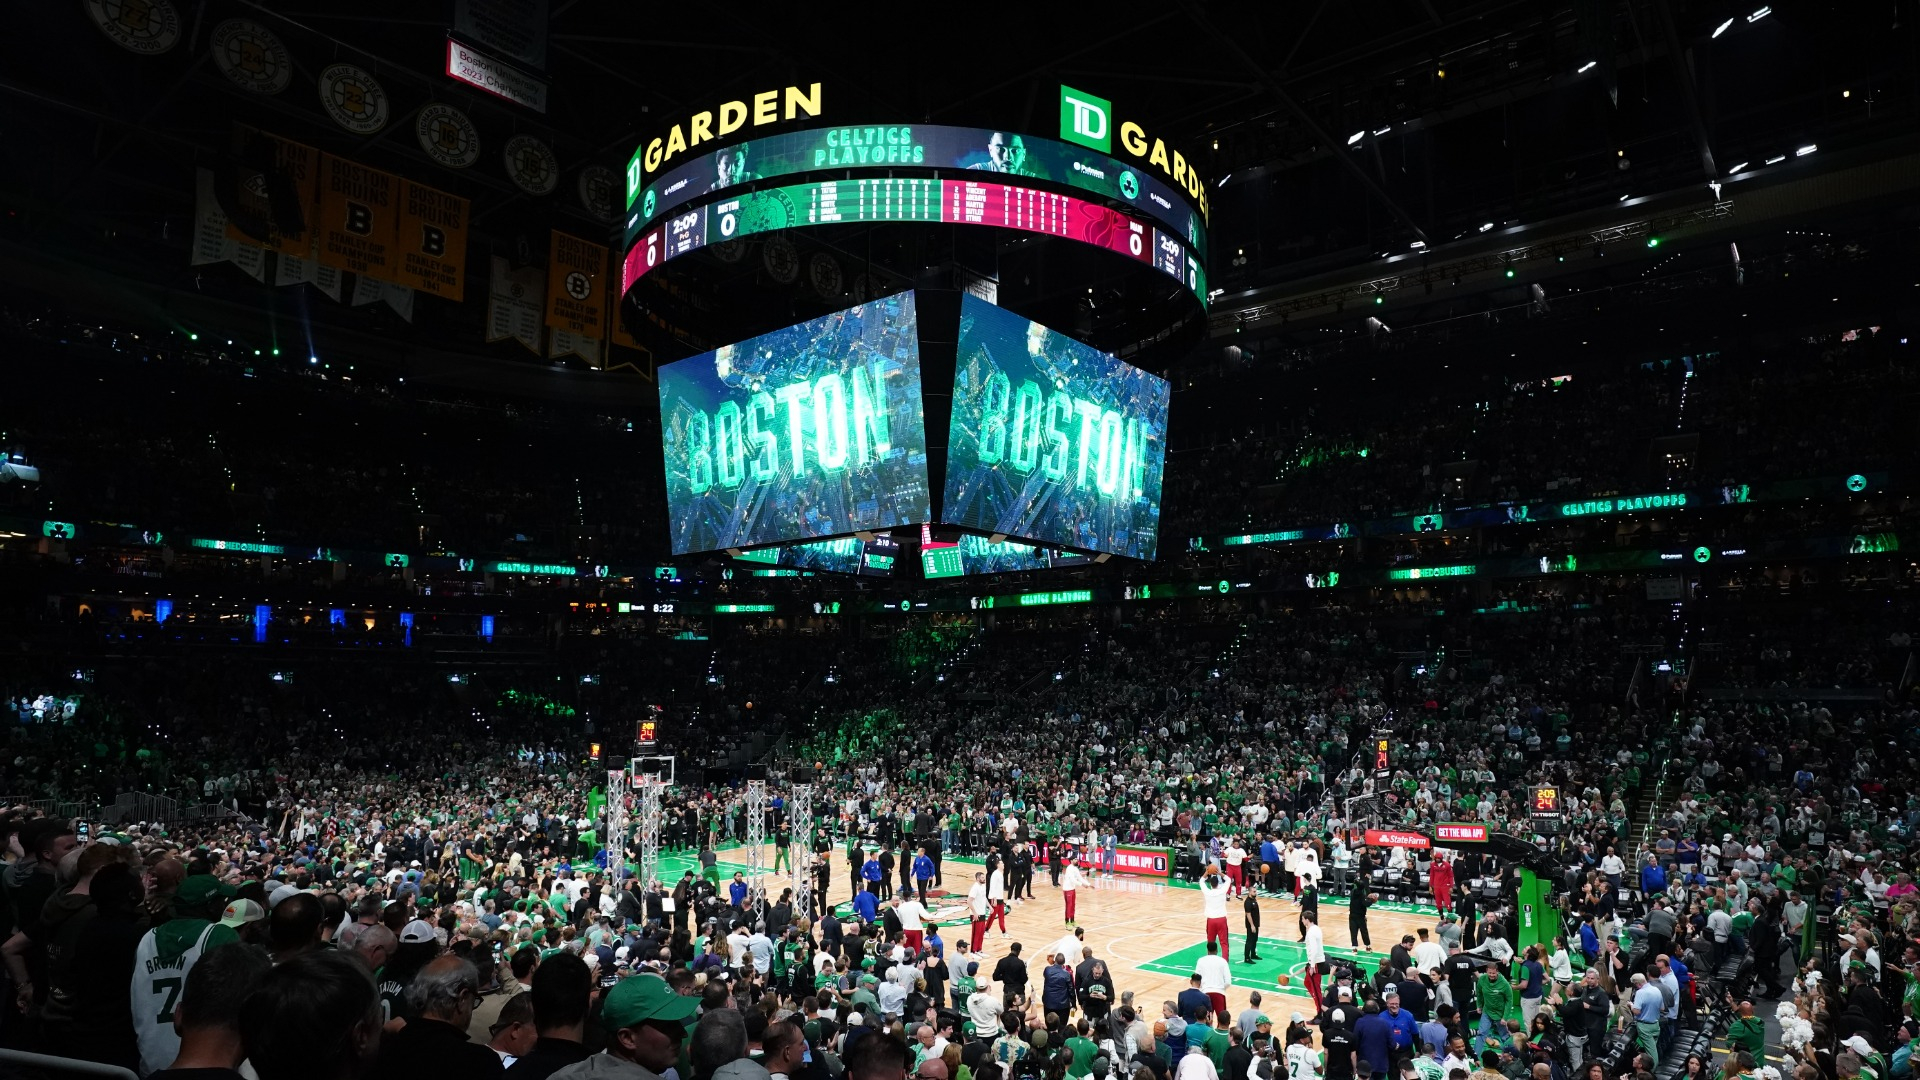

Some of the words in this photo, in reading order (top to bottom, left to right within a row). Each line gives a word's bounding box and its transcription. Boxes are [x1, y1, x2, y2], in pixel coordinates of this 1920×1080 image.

[124, 7, 147, 23] 77
[243, 51, 262, 65] 24
[326, 67, 350, 82] WILLIE
[459, 50, 493, 73] Boston
[495, 65, 540, 94] University
[462, 65, 482, 81] 2023
[486, 75, 538, 105] Champions
[346, 91, 362, 105] 22
[420, 107, 439, 136] RICHARD
[644, 82, 822, 174] GARDEN
[1065, 96, 1107, 140] TD
[442, 127, 456, 144] 16
[827, 127, 911, 147] CELTICS
[524, 155, 539, 174] 15
[815, 145, 924, 166] PLAYOFFS
[332, 158, 389, 190] BOSTON
[627, 157, 640, 198] TD
[331, 175, 389, 207] BRUINS
[409, 184, 461, 214] BOSTON
[345, 199, 373, 237] B
[408, 199, 461, 229] BRUINS
[673, 212, 698, 235] 2:09
[720, 213, 735, 236] 0
[329, 230, 368, 249] STANLEY
[368, 242, 385, 254] CUP
[421, 222, 447, 259] B
[558, 235, 602, 261] BOSTON
[1129, 233, 1142, 256] 0
[1160, 235, 1180, 257] 2:09
[327, 242, 386, 266] CHAMPIONS
[406, 253, 440, 270] STANLEY
[441, 262, 457, 274] CUP
[557, 248, 601, 275] BRUINS
[647, 245, 656, 267] 0
[405, 263, 457, 287] CHAMPIONS
[422, 279, 440, 292] 1941
[572, 276, 585, 295] B
[555, 298, 585, 312] STANLEY
[586, 305, 598, 314] CUP
[553, 308, 598, 327] CHAMPIONS
[688, 359, 892, 495] BOSTON
[978, 369, 1149, 503] BOSTON
[1562, 500, 1611, 516] CELTICS
[1617, 494, 1686, 511] PLAYOFFS
[876, 538, 889, 546] 2:10
[1269, 530, 1303, 542] BUSINESS
[247, 543, 284, 554] BUSINESS
[497, 562, 531, 573] CELTICS
[533, 563, 576, 575] PLAYOFFS
[1439, 565, 1476, 576] BUSINESS
[653, 604, 674, 613] 8:22
[1021, 595, 1046, 605] CELTICS
[1052, 591, 1091, 603] PLAYOFFS
[640, 730, 653, 741] 24
[1377, 752, 1388, 769] 24
[1537, 789, 1556, 799] 2:09
[1538, 798, 1554, 809] 24
[1438, 828, 1448, 837] GET
[1449, 828, 1460, 837] THE
[1460, 829, 1471, 838] NBA
[1472, 829, 1483, 839] APP
[1117, 855, 1128, 867] THE
[1128, 856, 1140, 868] NBA
[1141, 857, 1152, 869] APP
[379, 981, 403, 997] TATUM
[153, 977, 183, 1024] 7
[1290, 1062, 1298, 1078] 7
